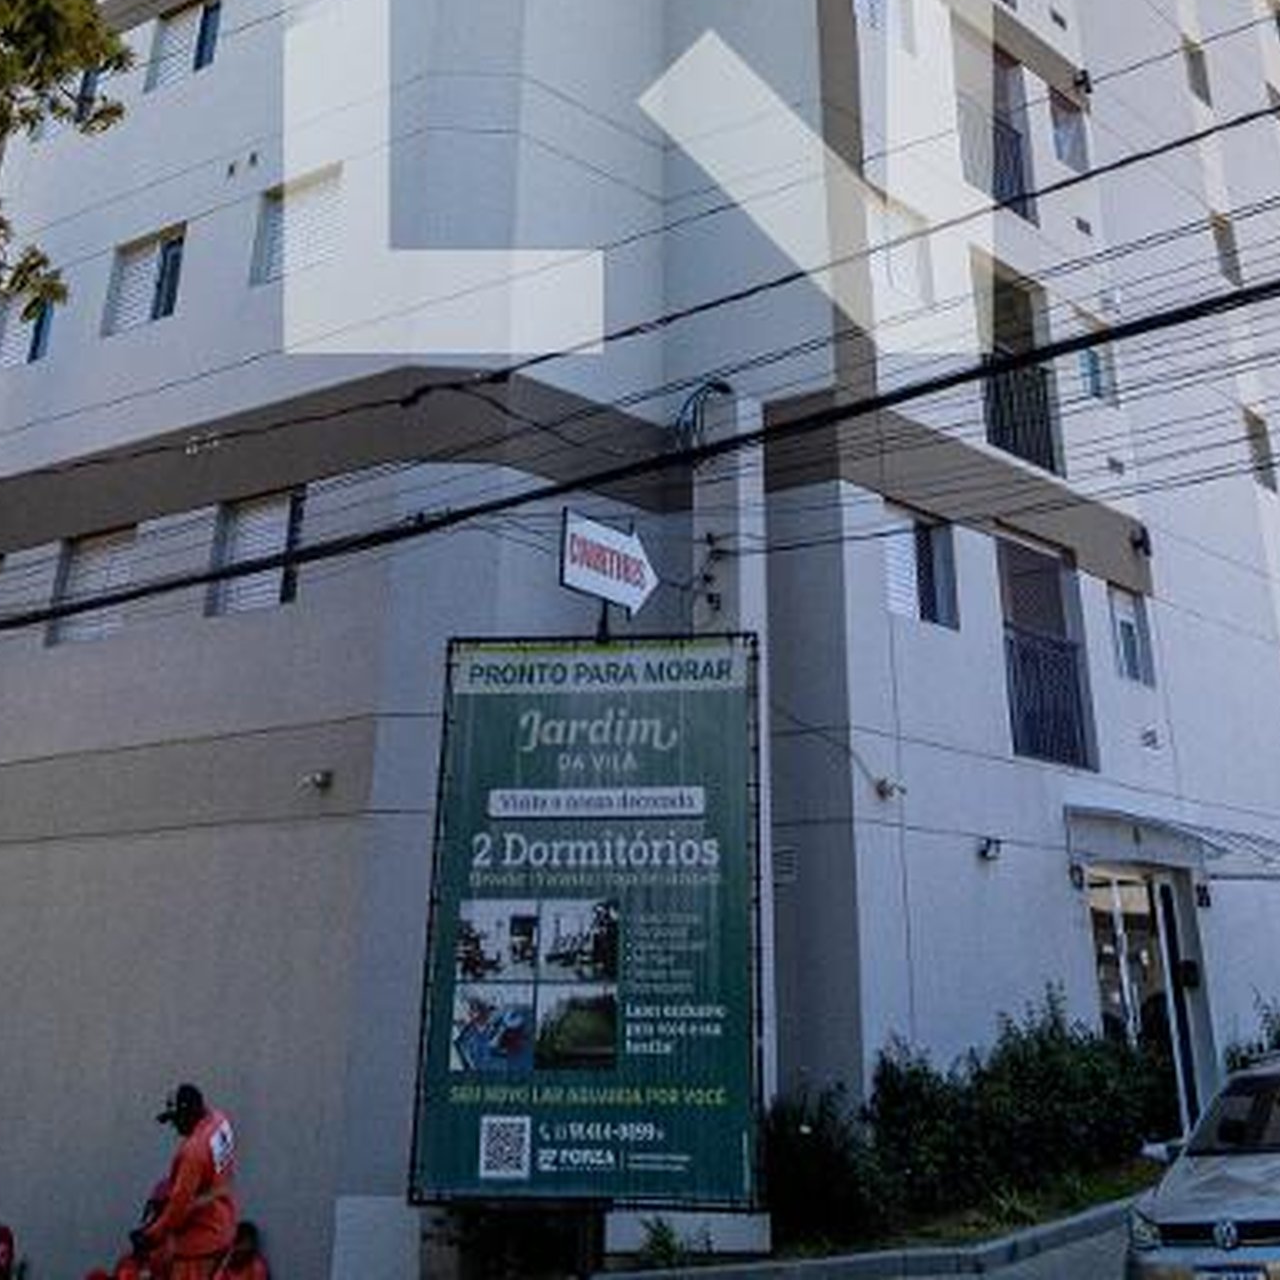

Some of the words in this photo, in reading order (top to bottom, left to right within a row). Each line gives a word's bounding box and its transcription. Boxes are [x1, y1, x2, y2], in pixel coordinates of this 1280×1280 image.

[470, 663, 567, 687] PRONTO
[574, 662, 638, 685] PARA
[646, 659, 733, 684] MORAR
[519, 701, 678, 752] Jardim
[472, 831, 491, 867] 2
[502, 828, 720, 867] Dormitórios
